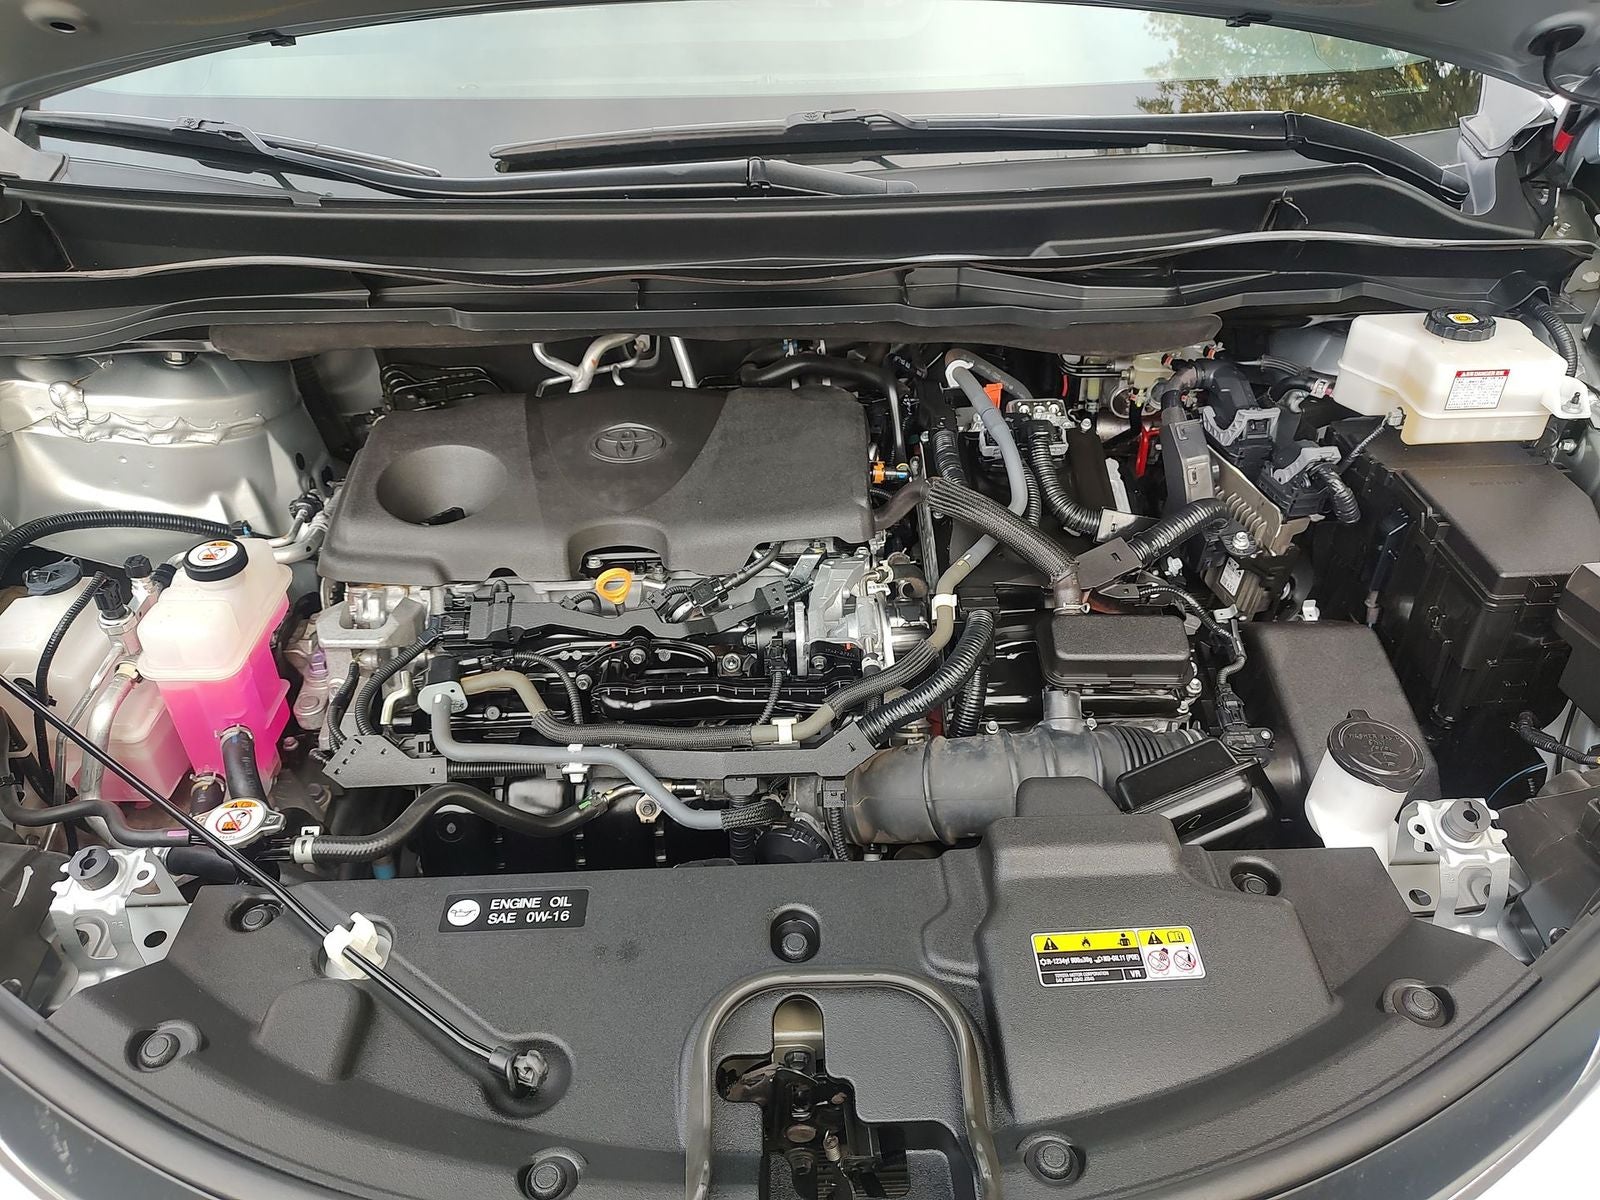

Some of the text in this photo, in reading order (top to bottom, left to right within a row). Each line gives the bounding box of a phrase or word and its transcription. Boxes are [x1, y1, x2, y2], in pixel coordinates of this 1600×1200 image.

[490, 896, 572, 910] ENGINE OIL
[487, 911, 570, 924] SAE 0W-16
[1130, 969, 1141, 978] VR
